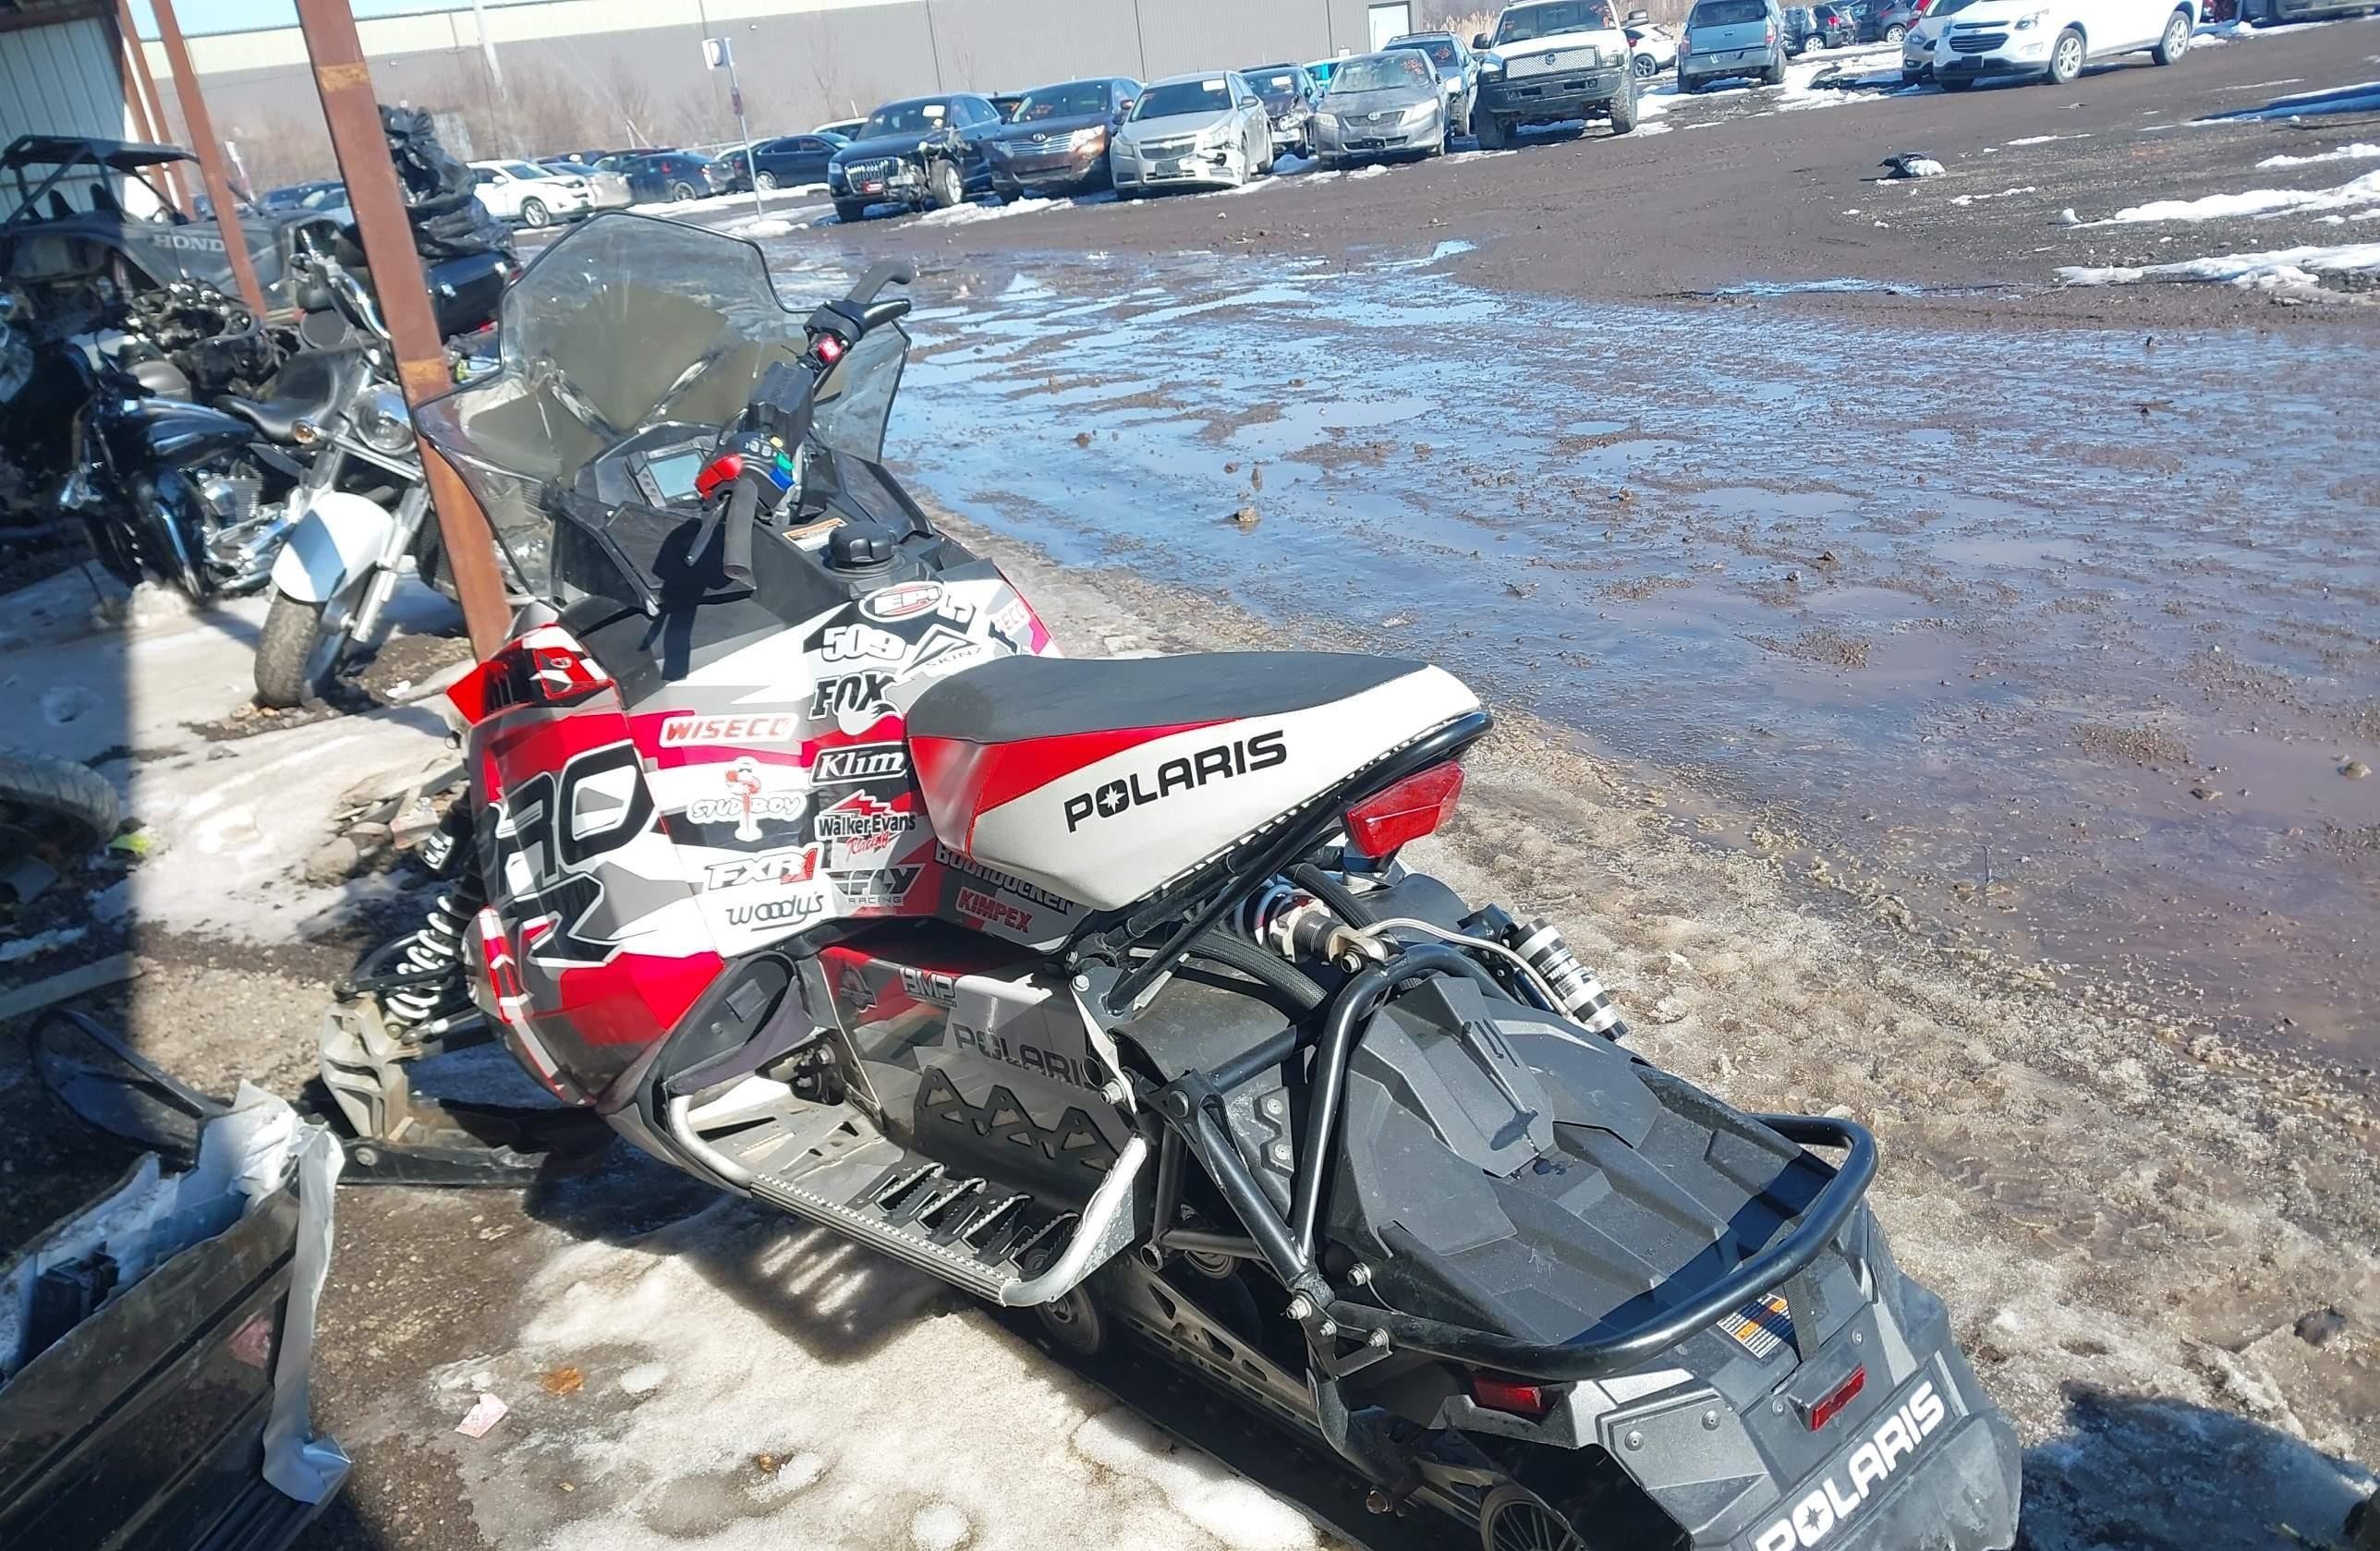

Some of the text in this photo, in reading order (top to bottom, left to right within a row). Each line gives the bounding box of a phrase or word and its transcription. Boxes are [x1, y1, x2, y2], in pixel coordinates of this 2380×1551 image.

[152, 234, 227, 251] HOND
[823, 624, 908, 662] 509
[810, 671, 896, 720] FOX
[666, 718, 792, 741] WISECO
[817, 751, 905, 780] Klim
[1063, 730, 1287, 833] POLARIS
[726, 891, 824, 931] woody's
[849, 895, 903, 904] RACING
[956, 888, 1033, 933] KIMPEX
[1755, 1380, 1945, 1551] POLARIS
